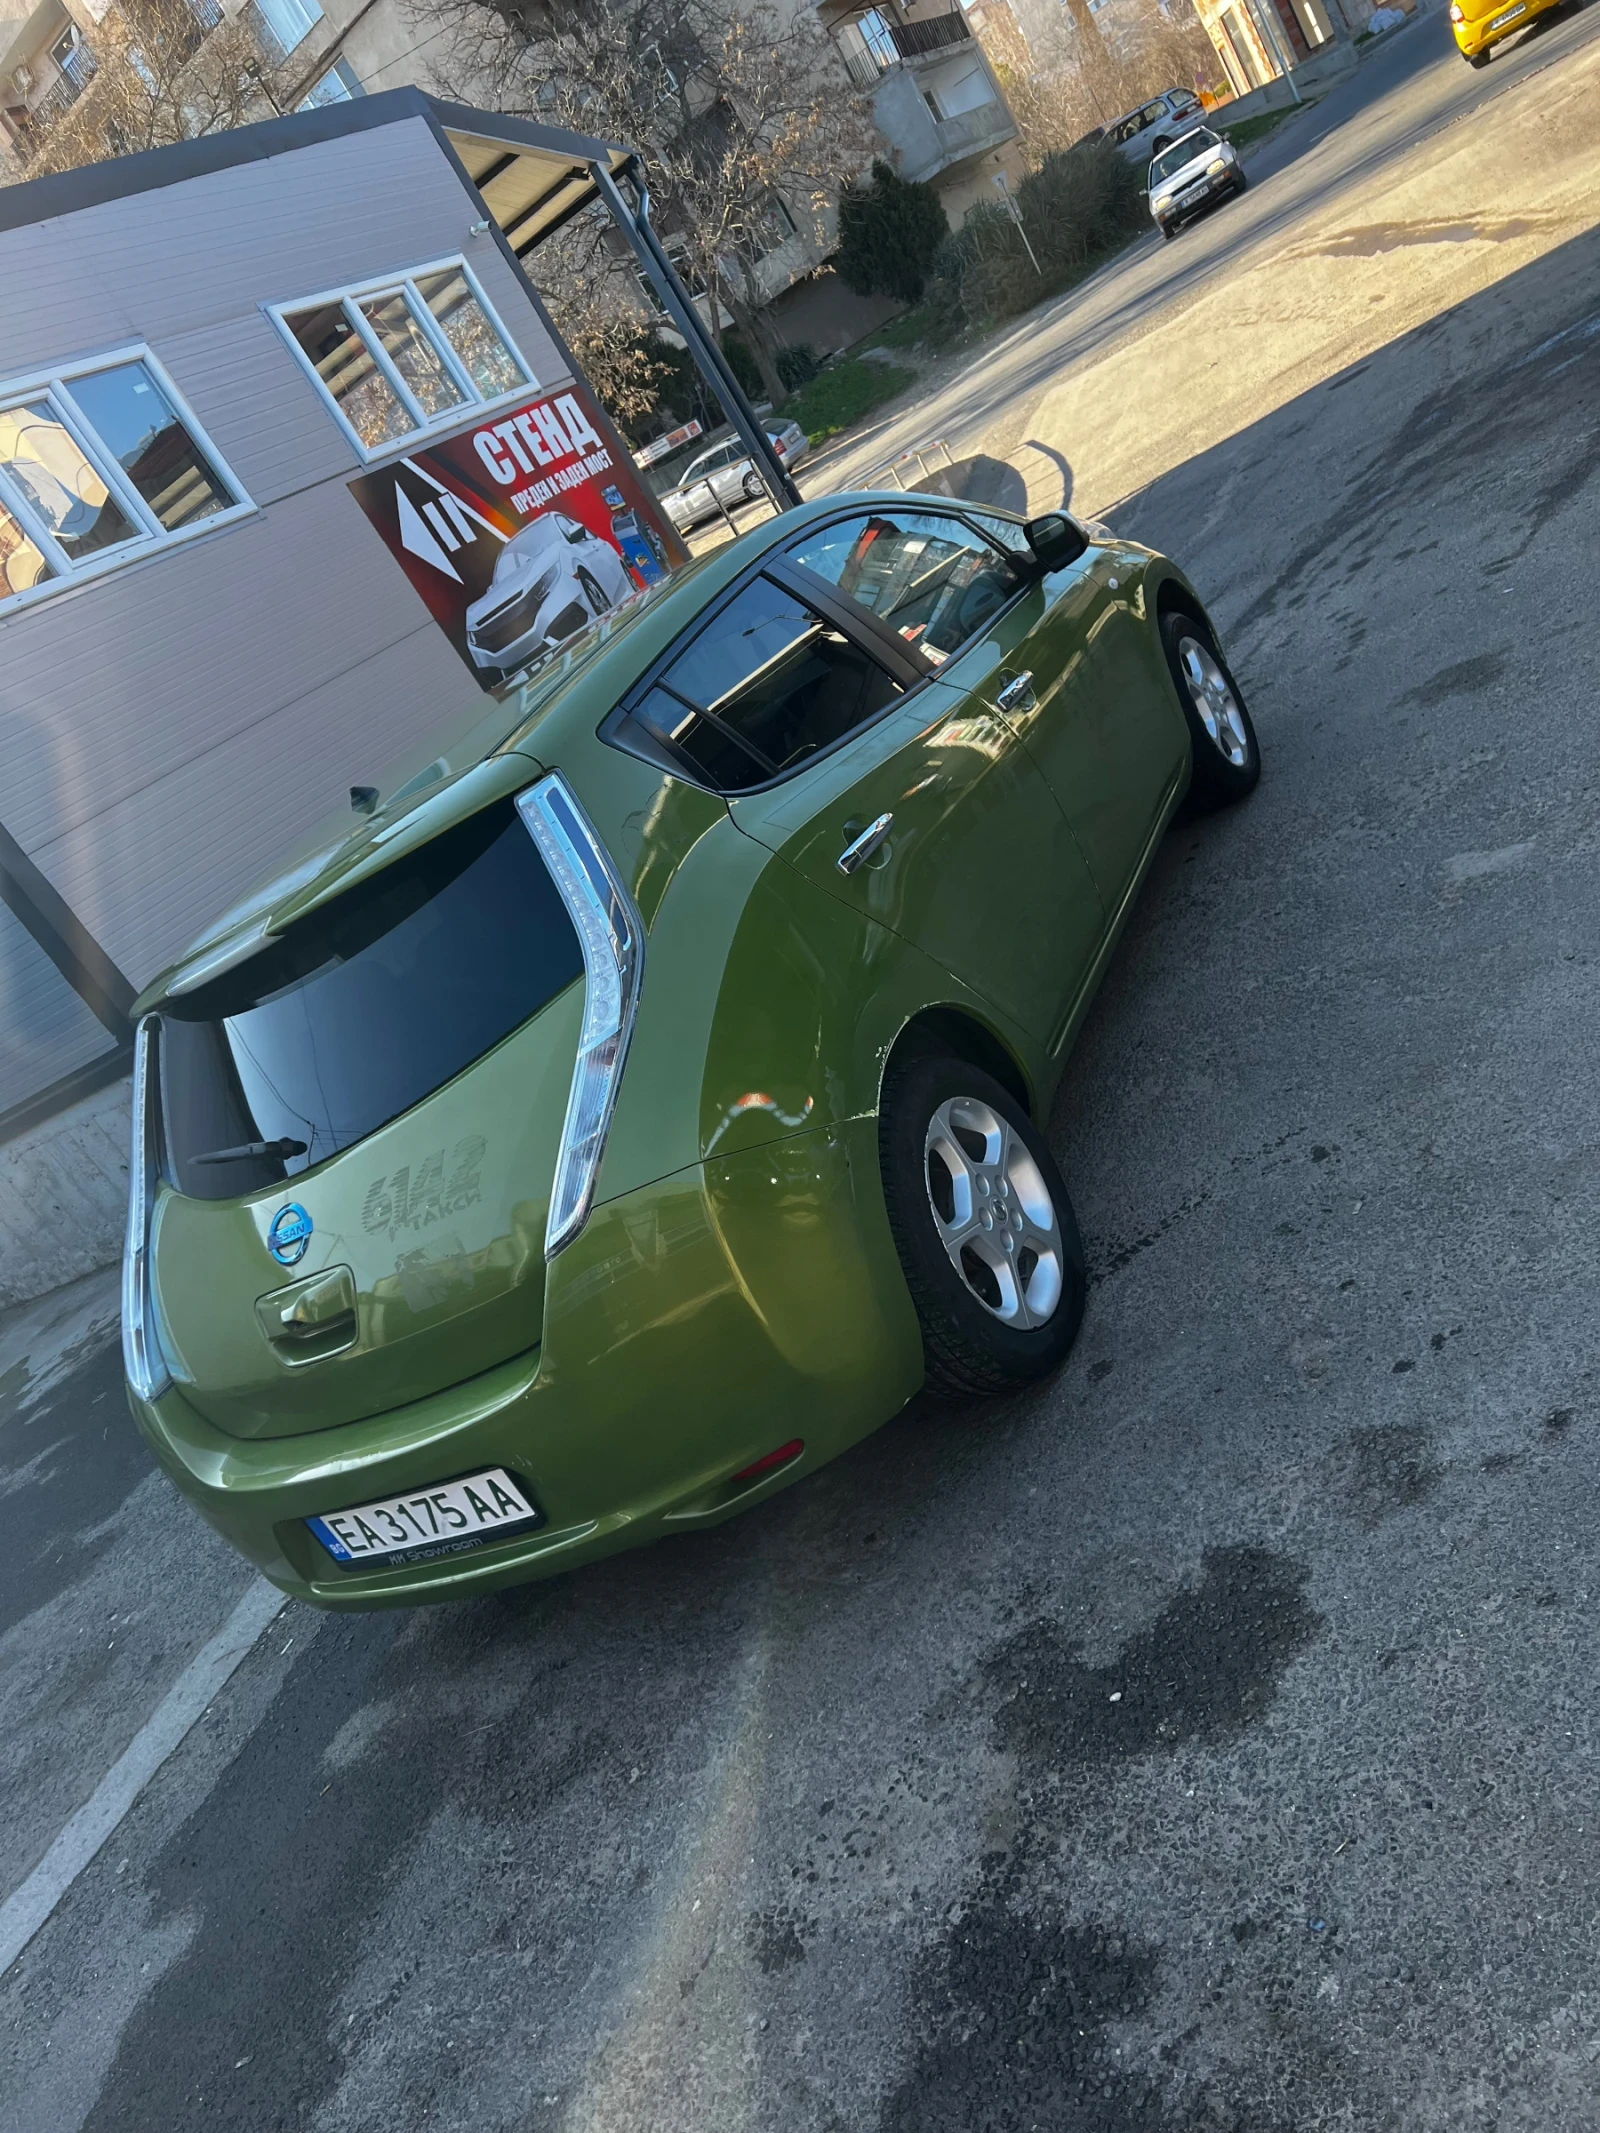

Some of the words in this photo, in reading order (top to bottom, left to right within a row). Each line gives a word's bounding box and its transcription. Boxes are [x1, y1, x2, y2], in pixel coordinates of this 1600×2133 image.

[473, 393, 603, 485] СТЕНД
[510, 480, 553, 514] ПРЕДЕН
[546, 476, 560, 495] И
[554, 461, 590, 488] ЗАДЕН
[583, 448, 613, 476] МОСТ
[407, 1188, 482, 1231] ТАКСИ
[269, 1223, 305, 1248] NSSAN
[329, 1543, 345, 1554] BG
[406, 1538, 483, 1561] Showroom
